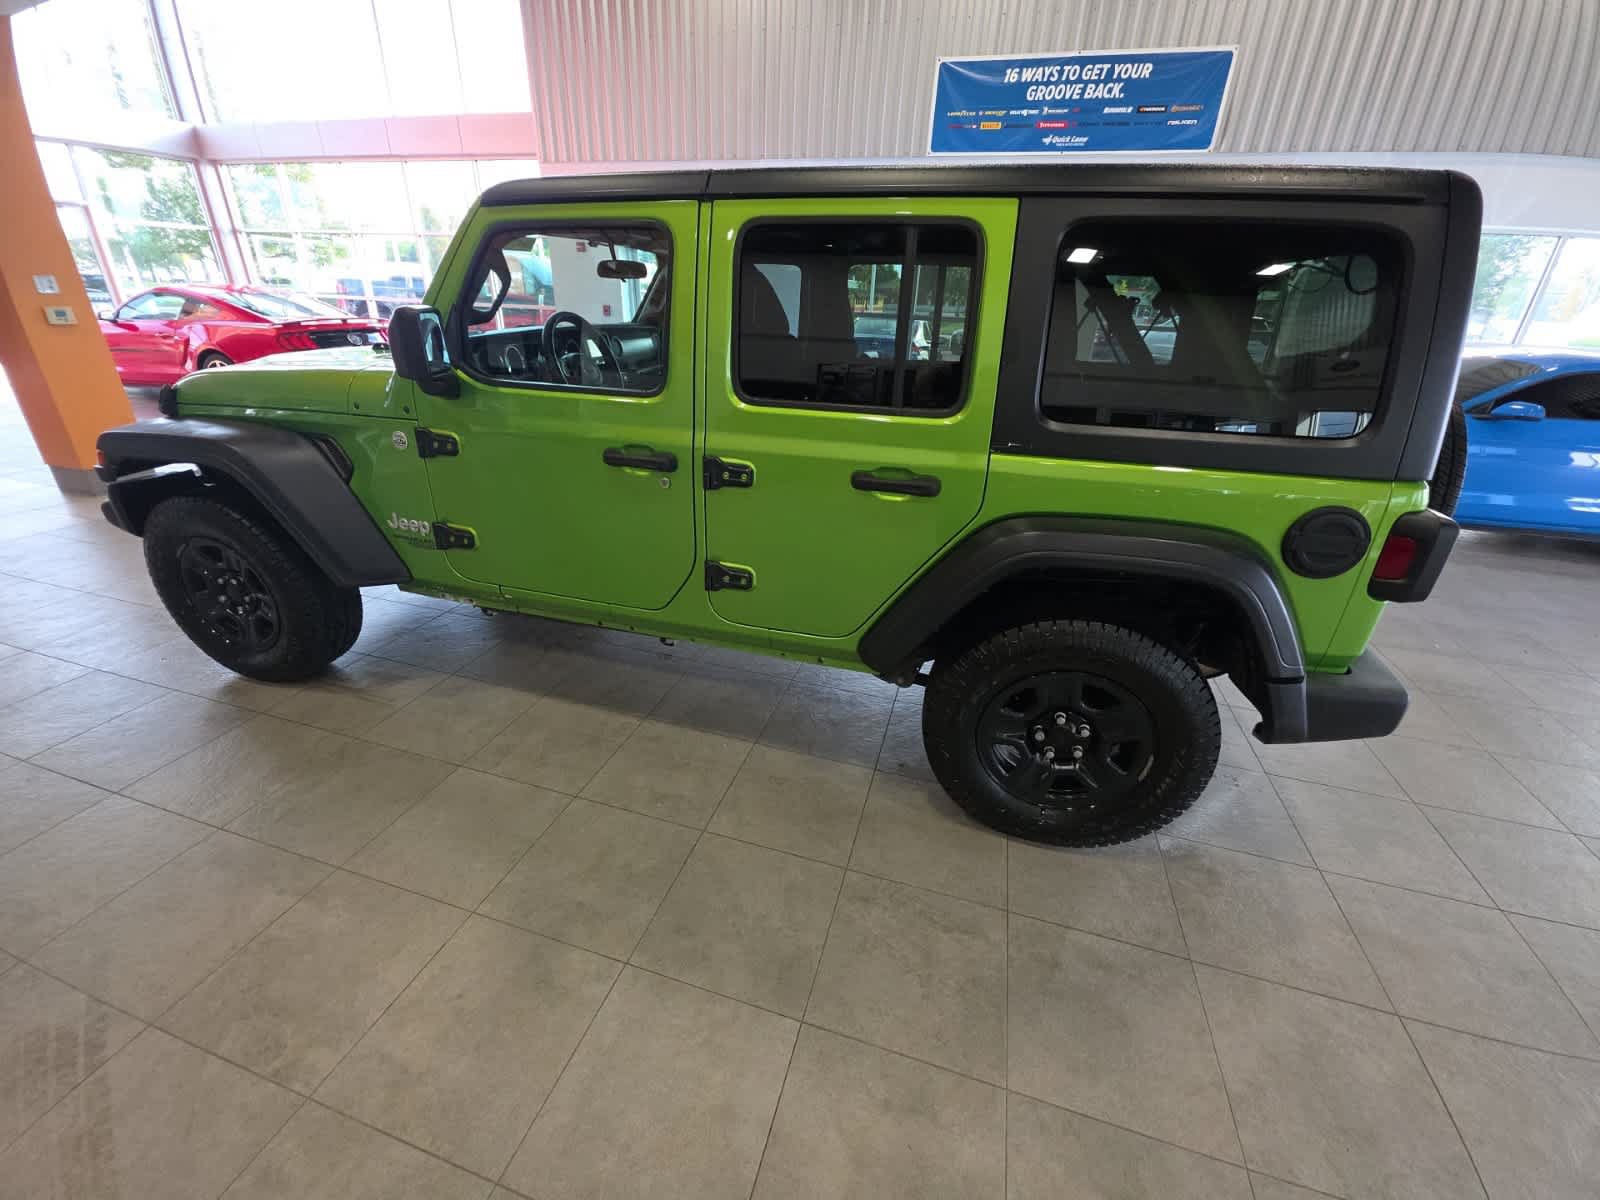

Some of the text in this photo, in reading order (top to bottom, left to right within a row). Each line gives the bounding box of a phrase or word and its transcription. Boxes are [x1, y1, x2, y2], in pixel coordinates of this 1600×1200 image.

[1003, 62, 1153, 83] 16 WAYS TO GET YOUR
[1026, 82, 1125, 101] GROOVE BACK.
[1071, 135, 1089, 143] Lane
[387, 512, 430, 537] Jeep
